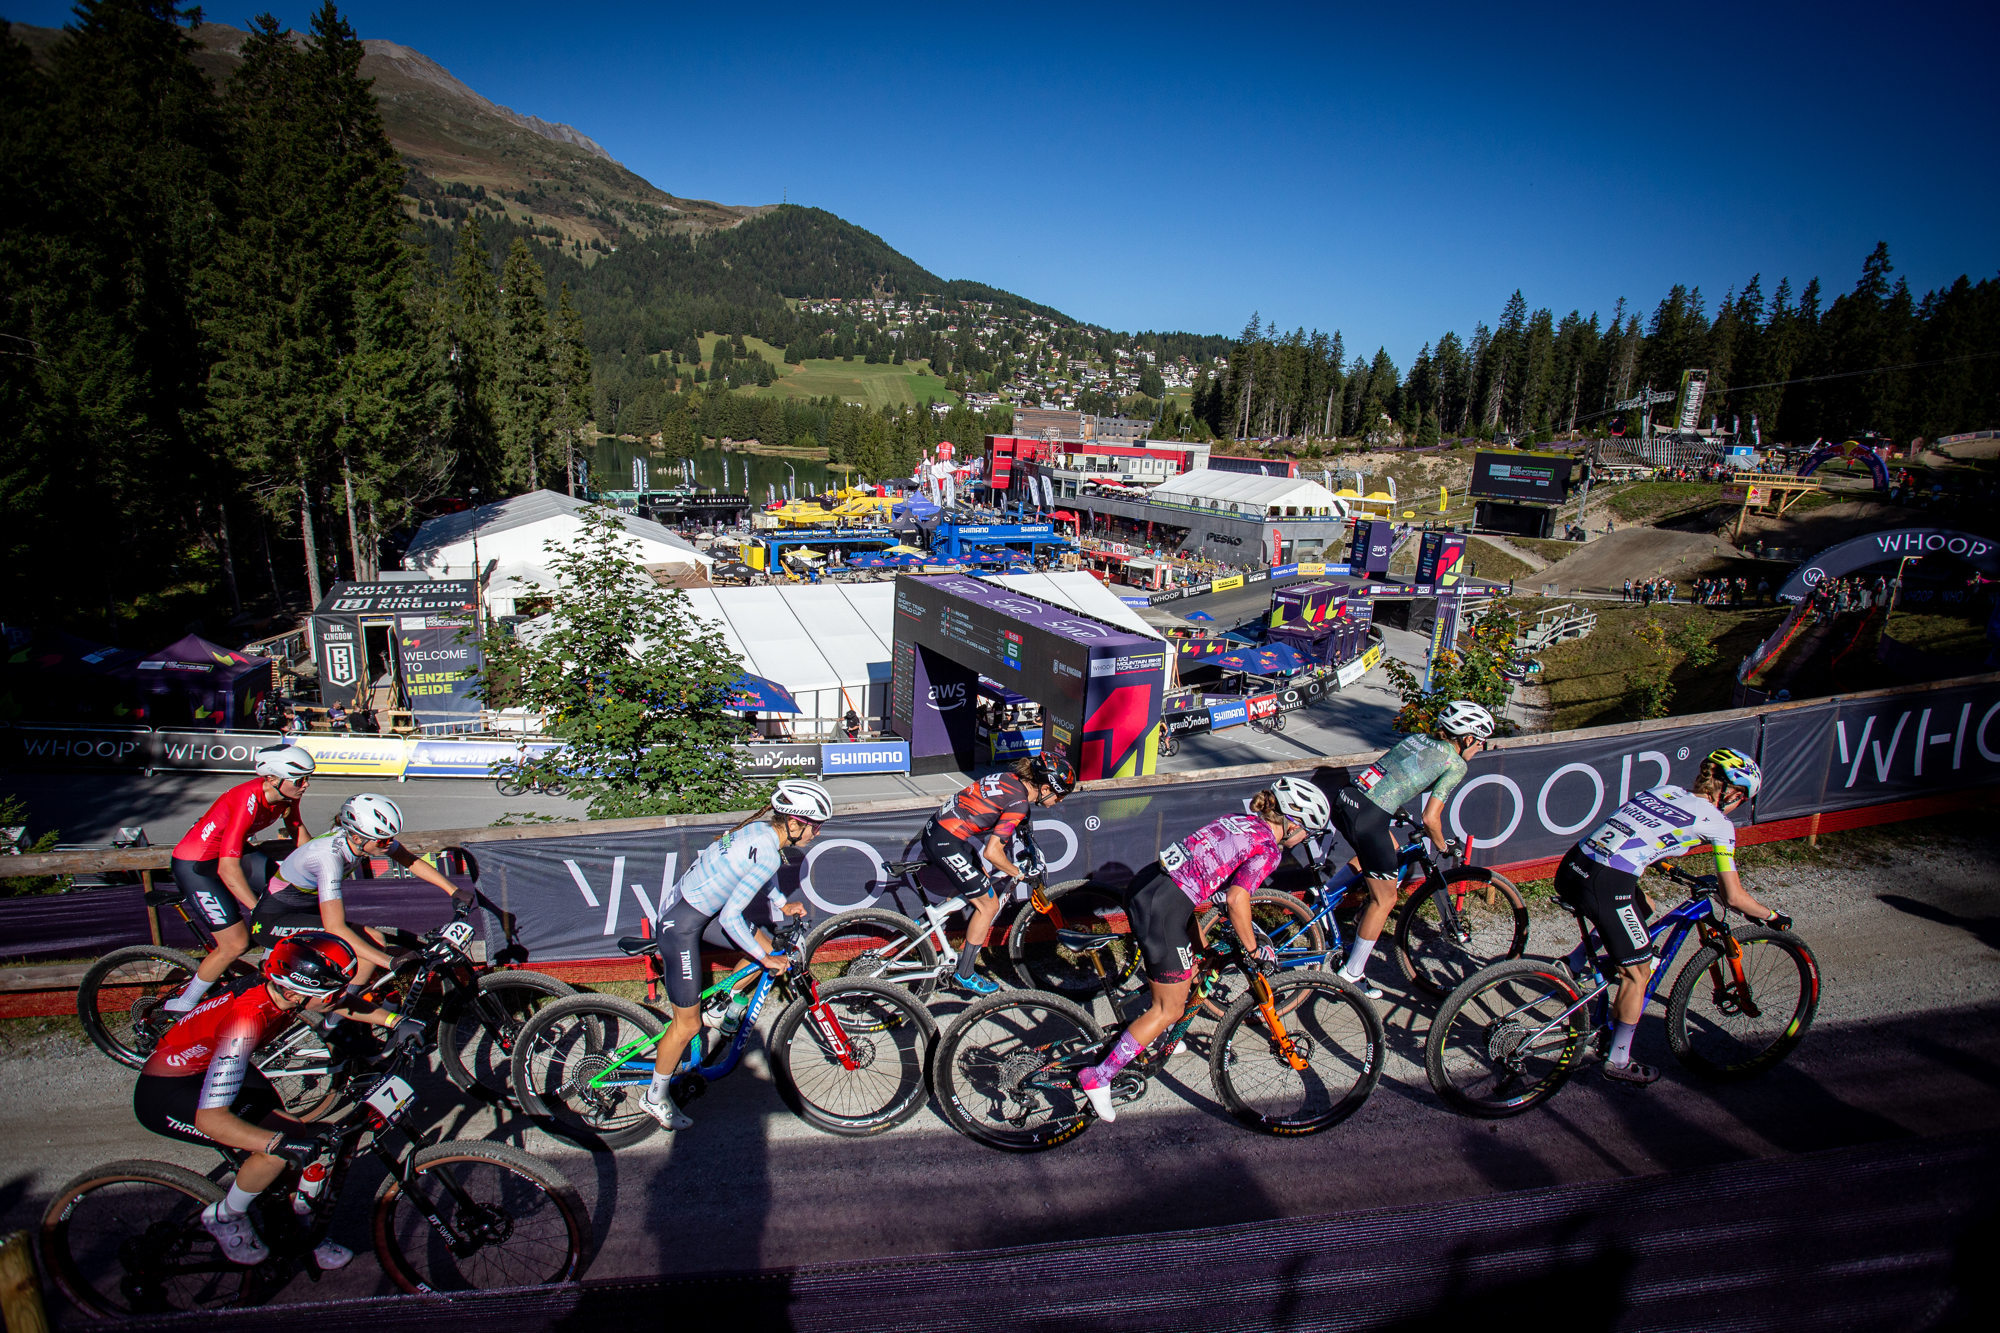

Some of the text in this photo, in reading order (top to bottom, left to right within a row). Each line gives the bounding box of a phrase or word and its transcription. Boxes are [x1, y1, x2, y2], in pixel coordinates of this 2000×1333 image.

[1206, 532, 1242, 546] PESKO
[1877, 534, 1989, 557] WHOOP
[1372, 545, 1387, 553] aws
[396, 587, 468, 595] LEGEND
[1152, 592, 1179, 603] WHOOP
[377, 600, 466, 609] KINGDOM
[323, 632, 353, 640] KINGDOM
[329, 624, 345, 633] BIKE
[403, 649, 468, 661] WELCOME
[1007, 642, 1018, 657] 6
[405, 663, 423, 672] TO
[1117, 658, 1148, 667] MOUNTAIN
[407, 684, 453, 696] HEIDE
[928, 682, 966, 700] aws
[1050, 713, 1075, 730] WHOOP
[1213, 707, 1245, 722] SHIMANO
[23, 738, 136, 759] WHOOP
[314, 750, 397, 761] MICHELIN
[830, 751, 903, 765] SHIMANO
[982, 772, 1000, 795] BH
[1364, 771, 1373, 780] 1
[775, 804, 816, 815] SPECIALIZED
[1622, 806, 1662, 829] vittoria
[200, 821, 215, 842] KTM
[1601, 831, 1616, 844] 2
[1164, 850, 1180, 866] 13
[1648, 845, 1681, 862] Autovega
[946, 852, 979, 881] BH
[196, 890, 228, 926] KTM
[450, 924, 468, 940] 22
[680, 950, 693, 980] TRINITY
[290, 971, 321, 987] GIRO
[737, 979, 773, 1051] S-WORKS
[819, 1020, 846, 1055] SID
[1363, 1042, 1374, 1075] DT SWISS
[364, 1077, 387, 1097] WHOOP
[381, 1087, 398, 1103] 7
[951, 1094, 973, 1123] DT SWISS
[1047, 1119, 1085, 1146] MAXXIS
[1272, 1125, 1316, 1135] MAXXIS
[428, 1214, 456, 1247] DT SWISS
